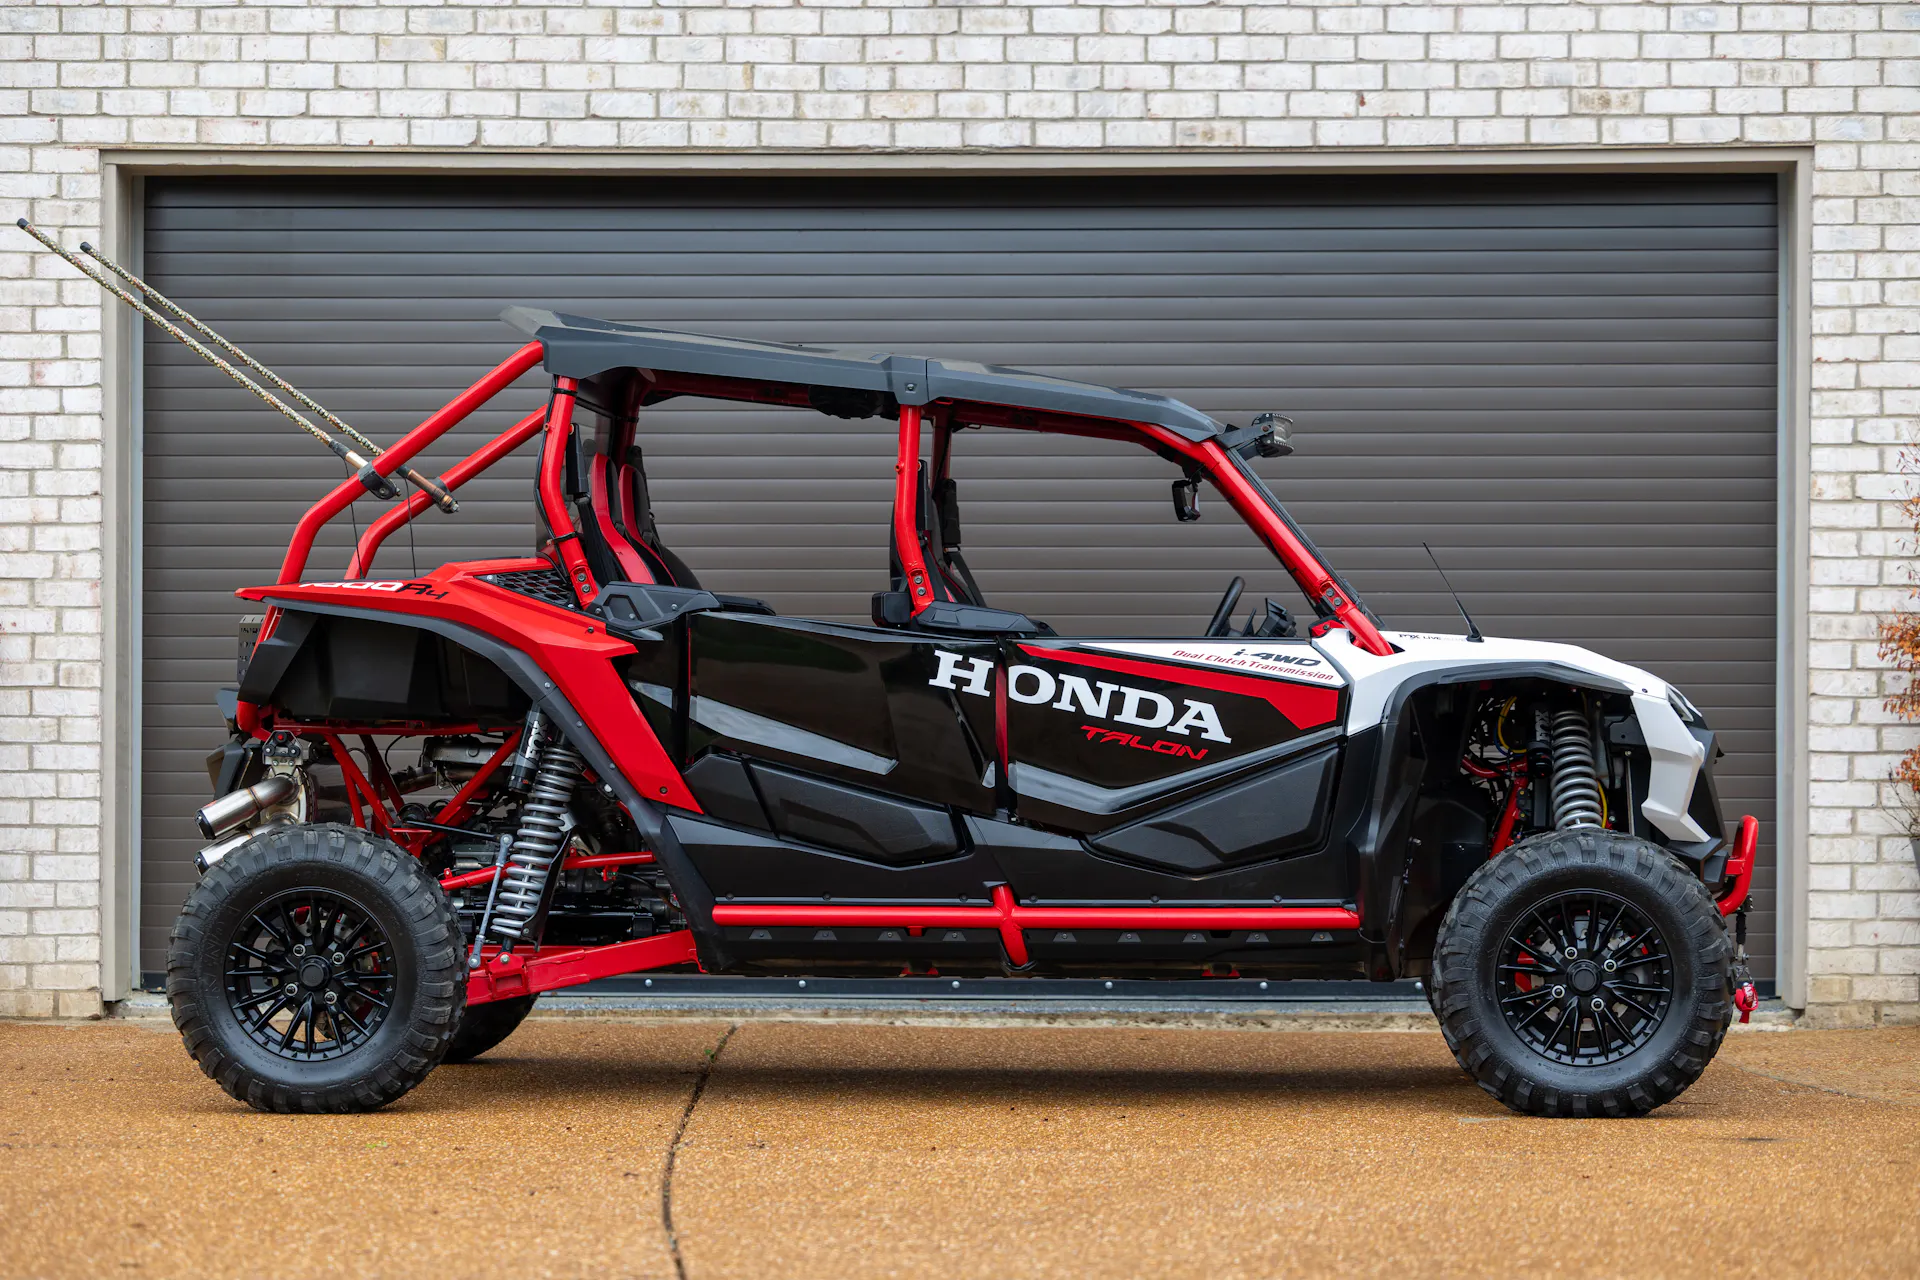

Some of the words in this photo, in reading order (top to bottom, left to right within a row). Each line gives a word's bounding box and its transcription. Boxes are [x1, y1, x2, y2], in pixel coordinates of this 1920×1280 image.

[1172, 649, 1201, 662] Dual
[1204, 653, 1247, 667] Clutch
[1249, 661, 1334, 681] Transmission
[1233, 648, 1322, 667] i-4WD
[928, 650, 1232, 744] HONDA
[525, 719, 548, 760] FOX
[1080, 725, 1209, 760] TALON
